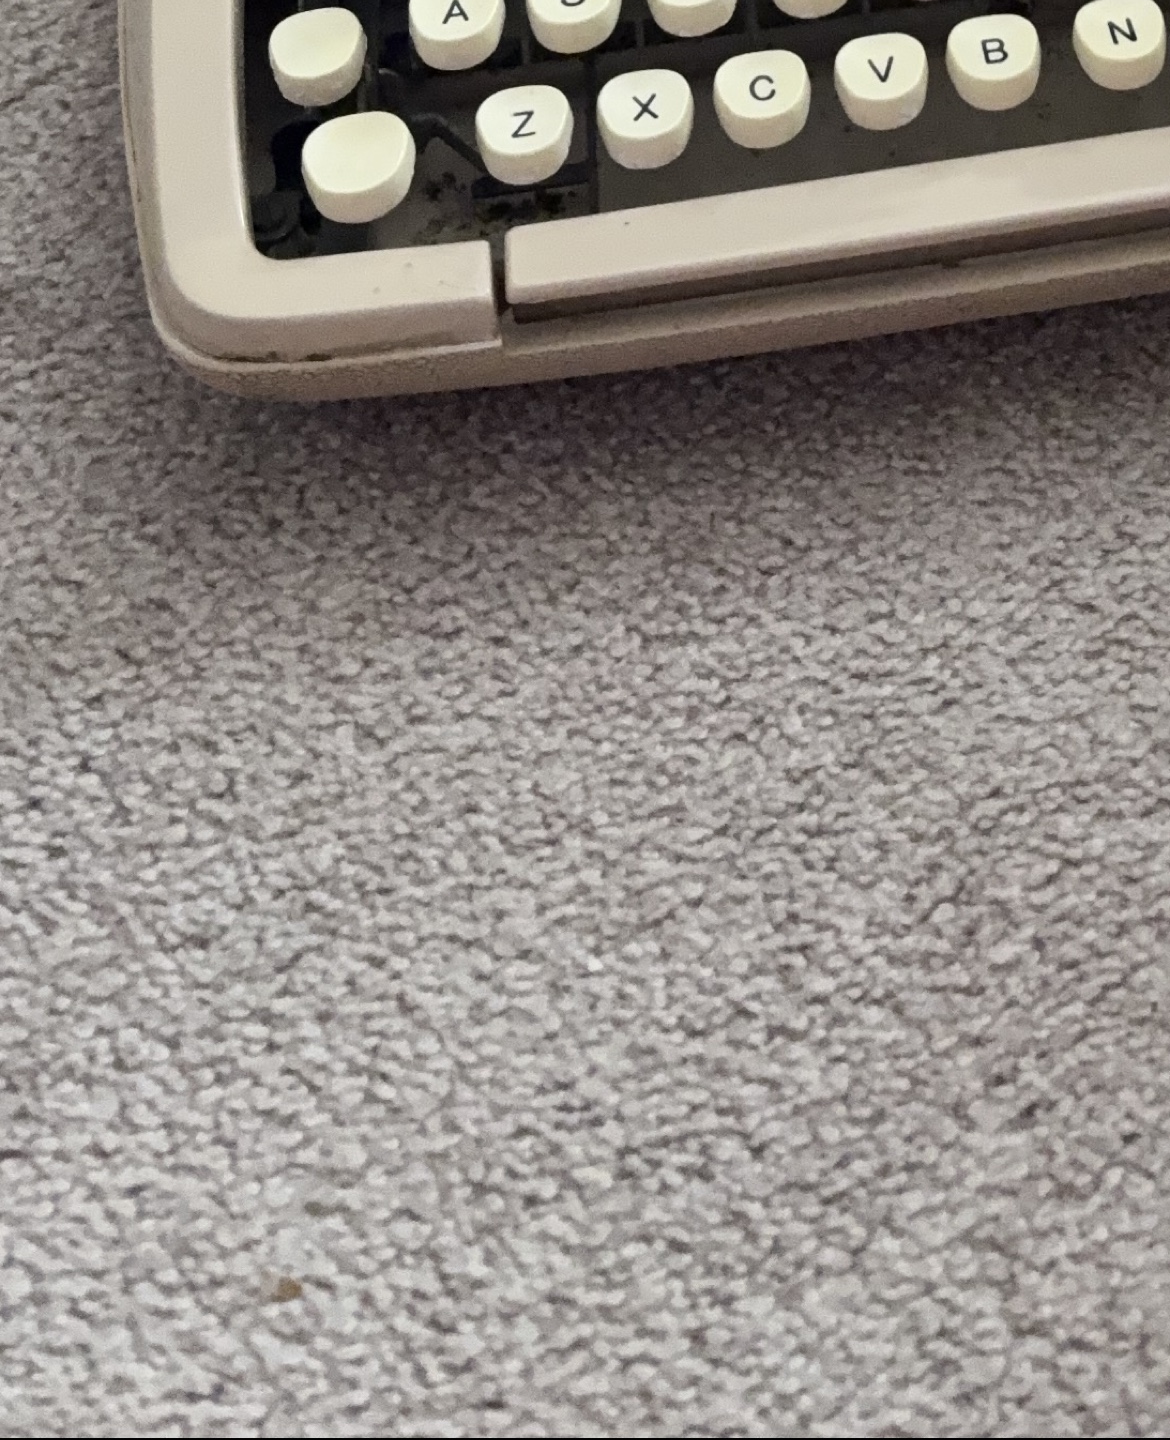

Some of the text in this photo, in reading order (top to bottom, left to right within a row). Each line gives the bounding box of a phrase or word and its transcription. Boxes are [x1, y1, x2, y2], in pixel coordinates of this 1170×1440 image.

[442, 0, 469, 25] A
[511, 110, 537, 139] Z
[632, 93, 659, 122] X
[749, 75, 776, 101] C
[867, 56, 894, 83] V
[981, 38, 1009, 65] B
[1107, 17, 1138, 45] N
